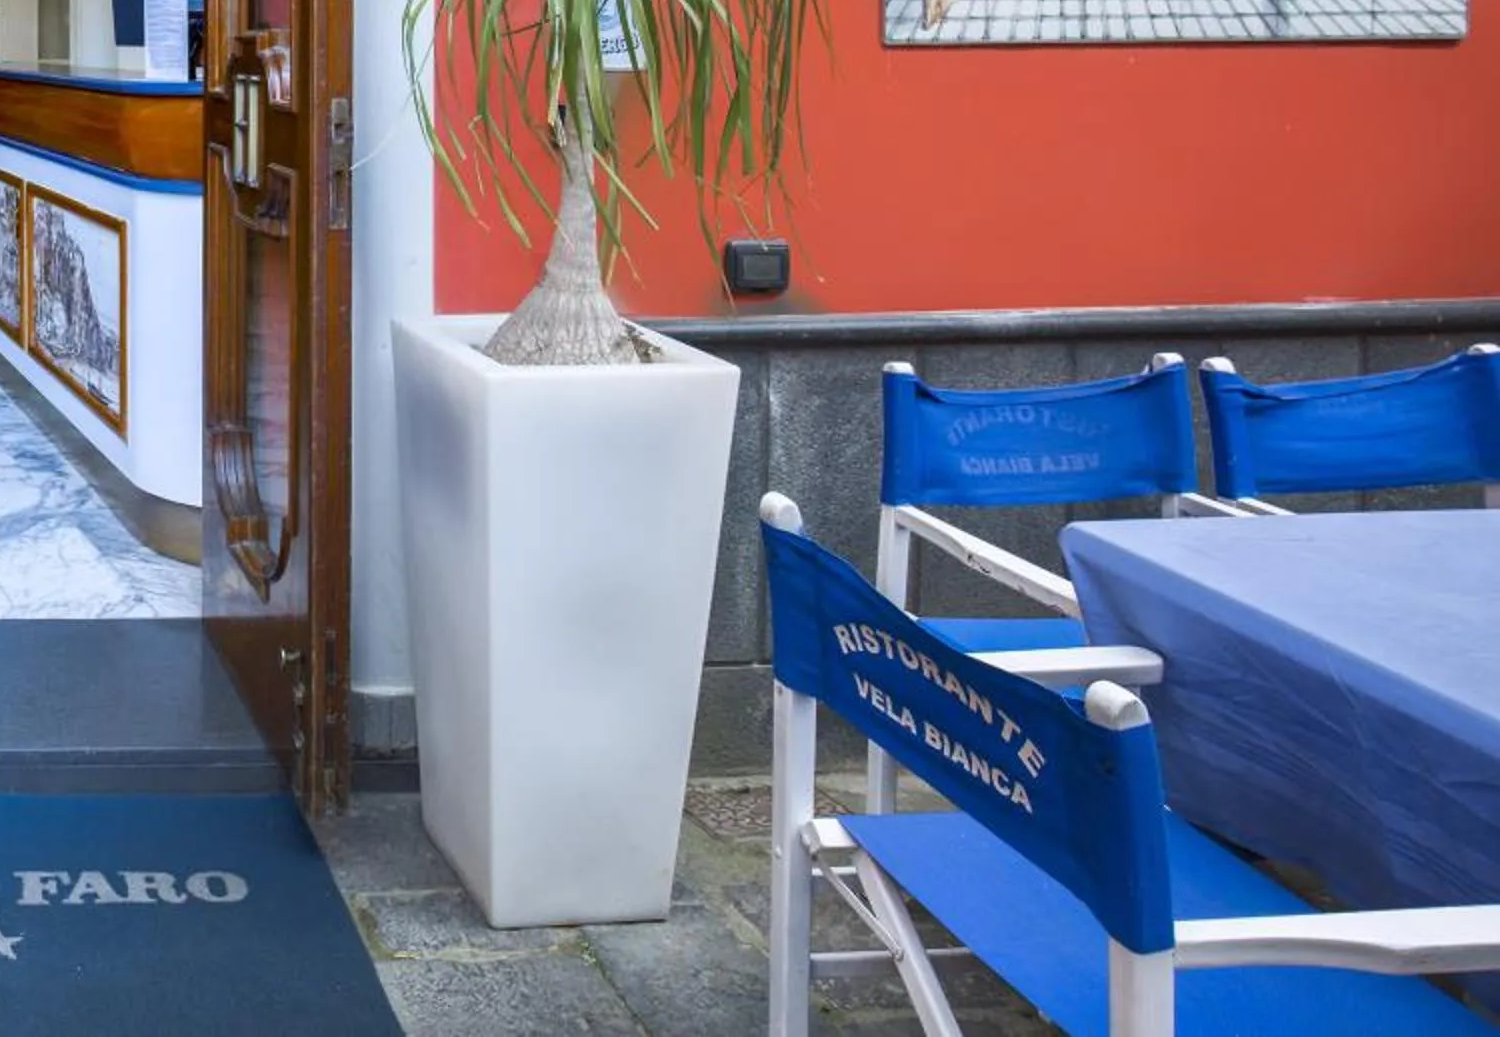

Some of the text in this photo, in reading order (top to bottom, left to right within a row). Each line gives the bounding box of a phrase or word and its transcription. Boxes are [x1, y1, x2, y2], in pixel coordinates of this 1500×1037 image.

[833, 622, 1046, 778] RISTORANTE
[853, 672, 1033, 814] VELA BIANCA
[16, 870, 248, 905] FARO
